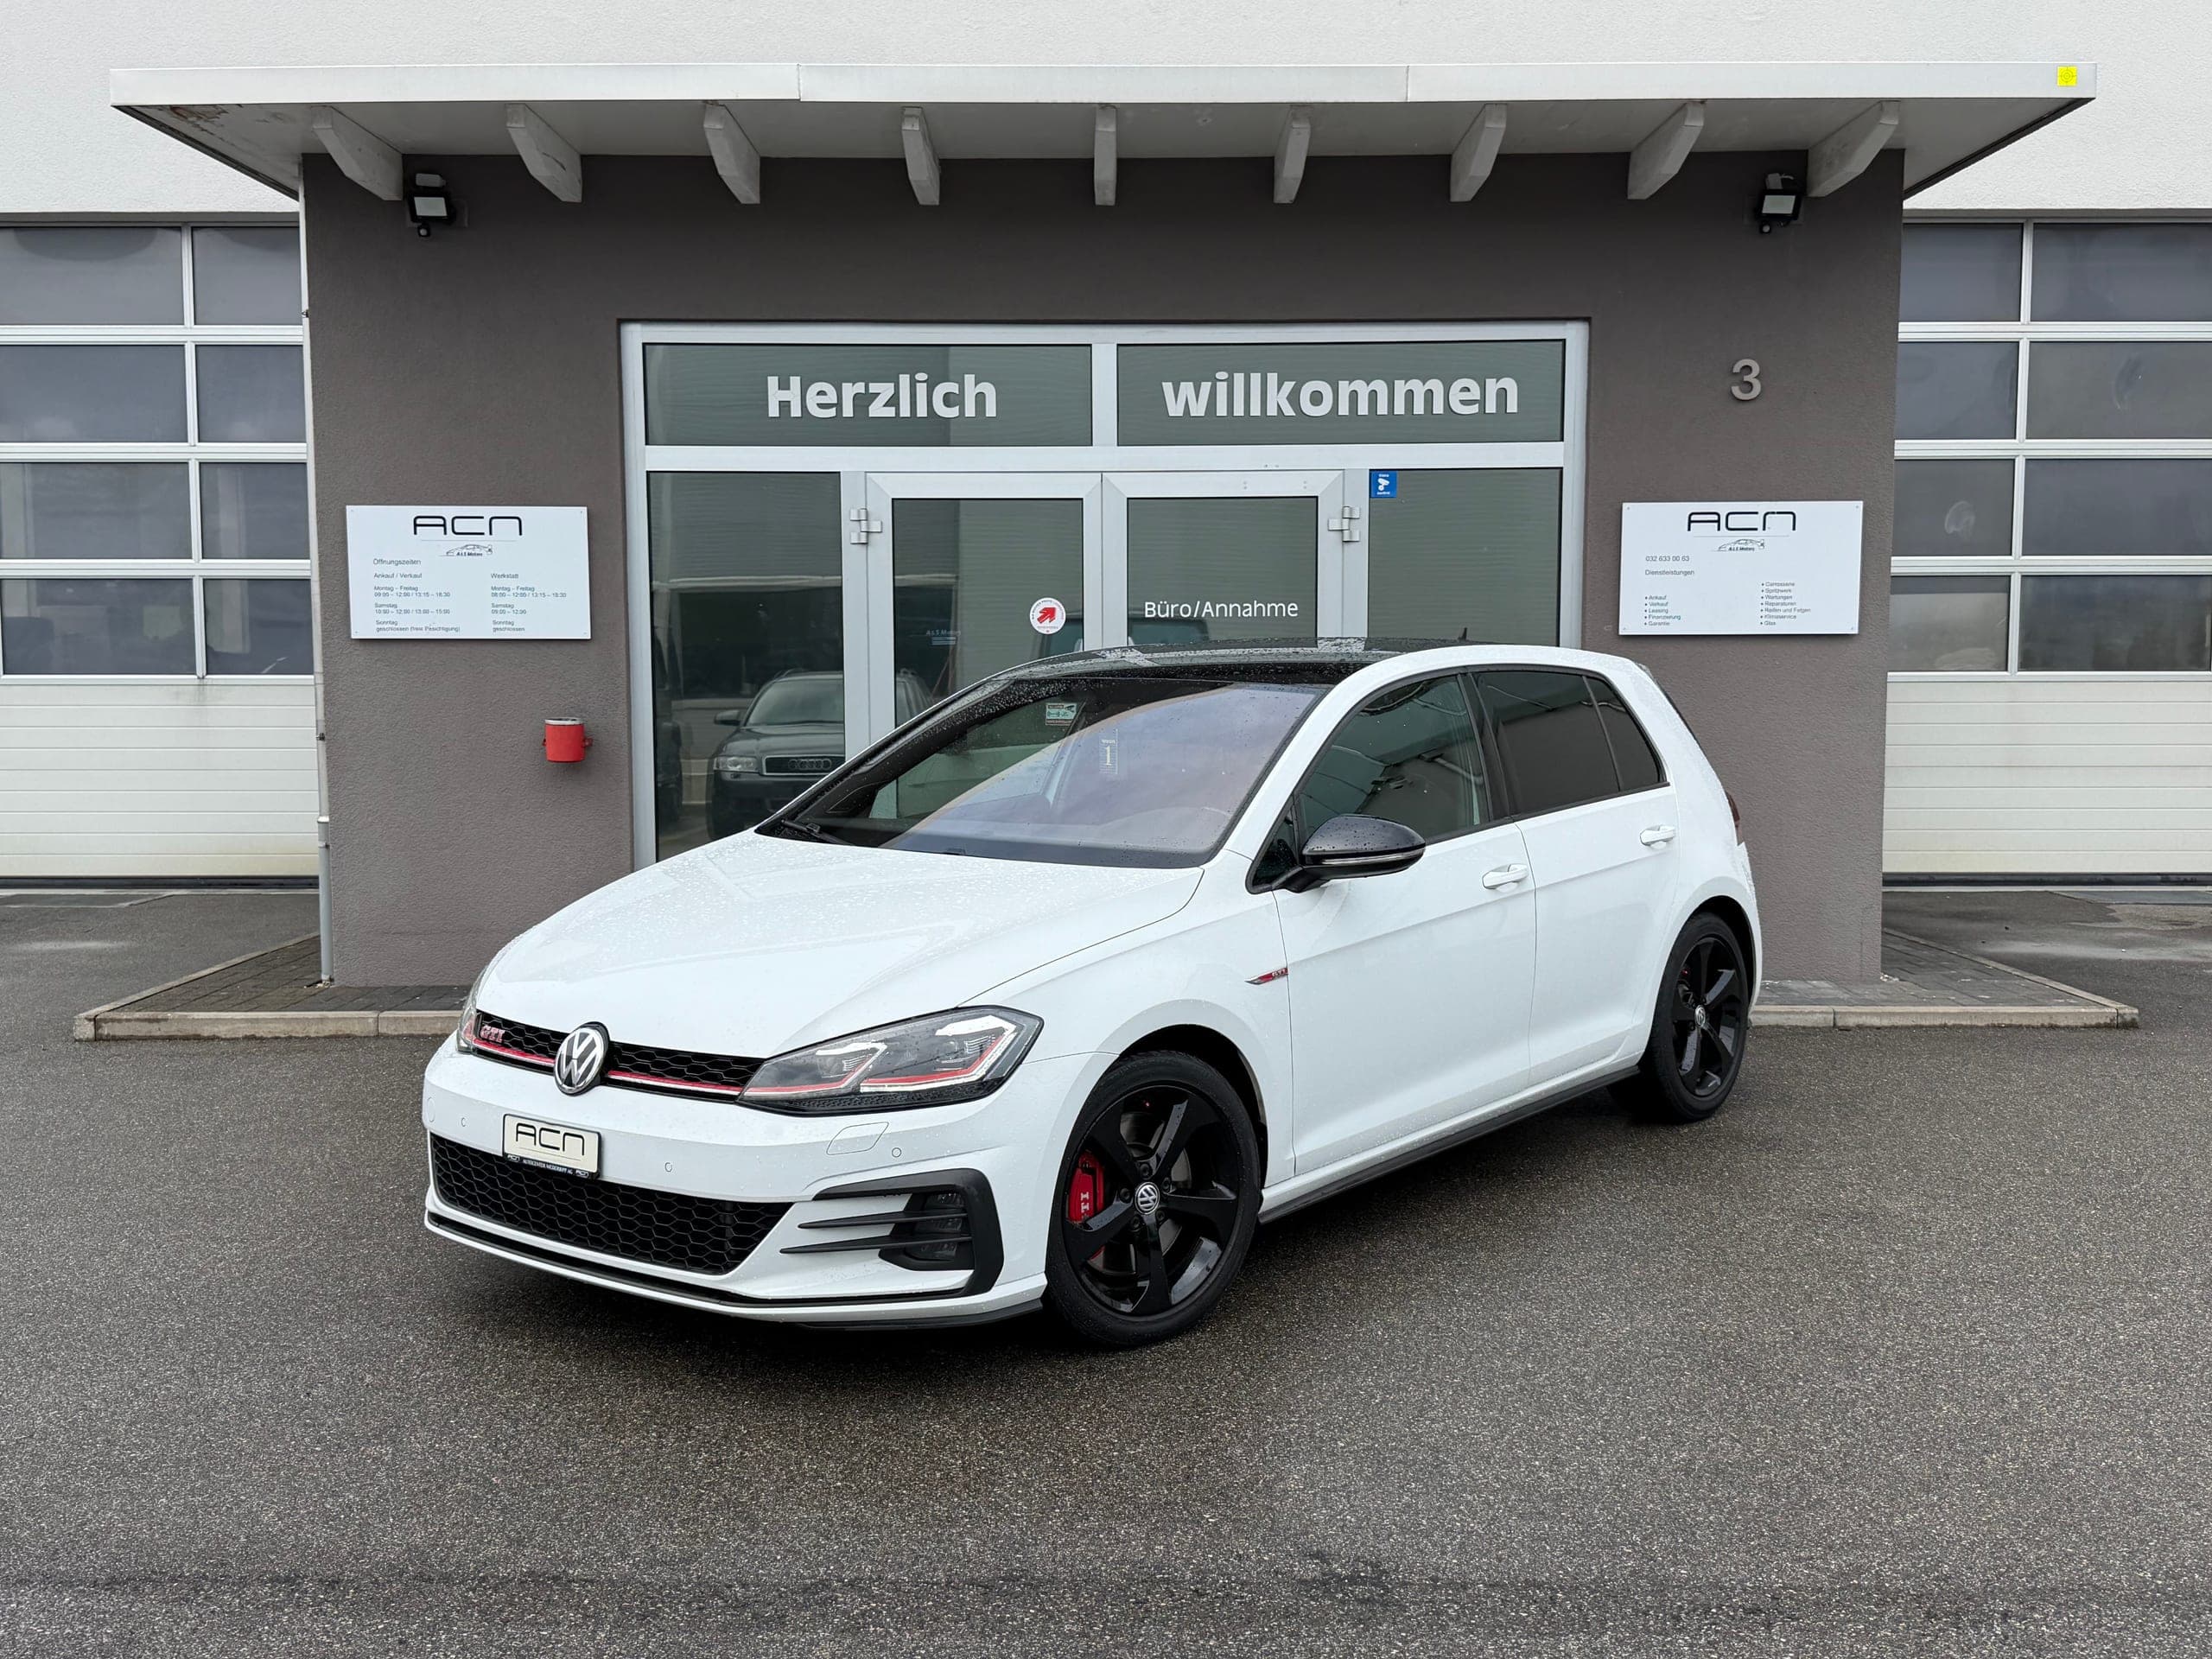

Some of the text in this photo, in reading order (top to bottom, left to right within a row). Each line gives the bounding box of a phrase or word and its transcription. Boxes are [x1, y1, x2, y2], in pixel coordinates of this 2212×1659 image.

[1731, 358, 1762, 401] 3
[766, 371, 1519, 419] Herzlich willkommen
[413, 515, 523, 536] ACN
[1688, 511, 1796, 531] ACN
[1144, 600, 1299, 619] Büro/Annahme
[480, 1025, 506, 1043] GTI
[515, 1122, 585, 1156] ACN
